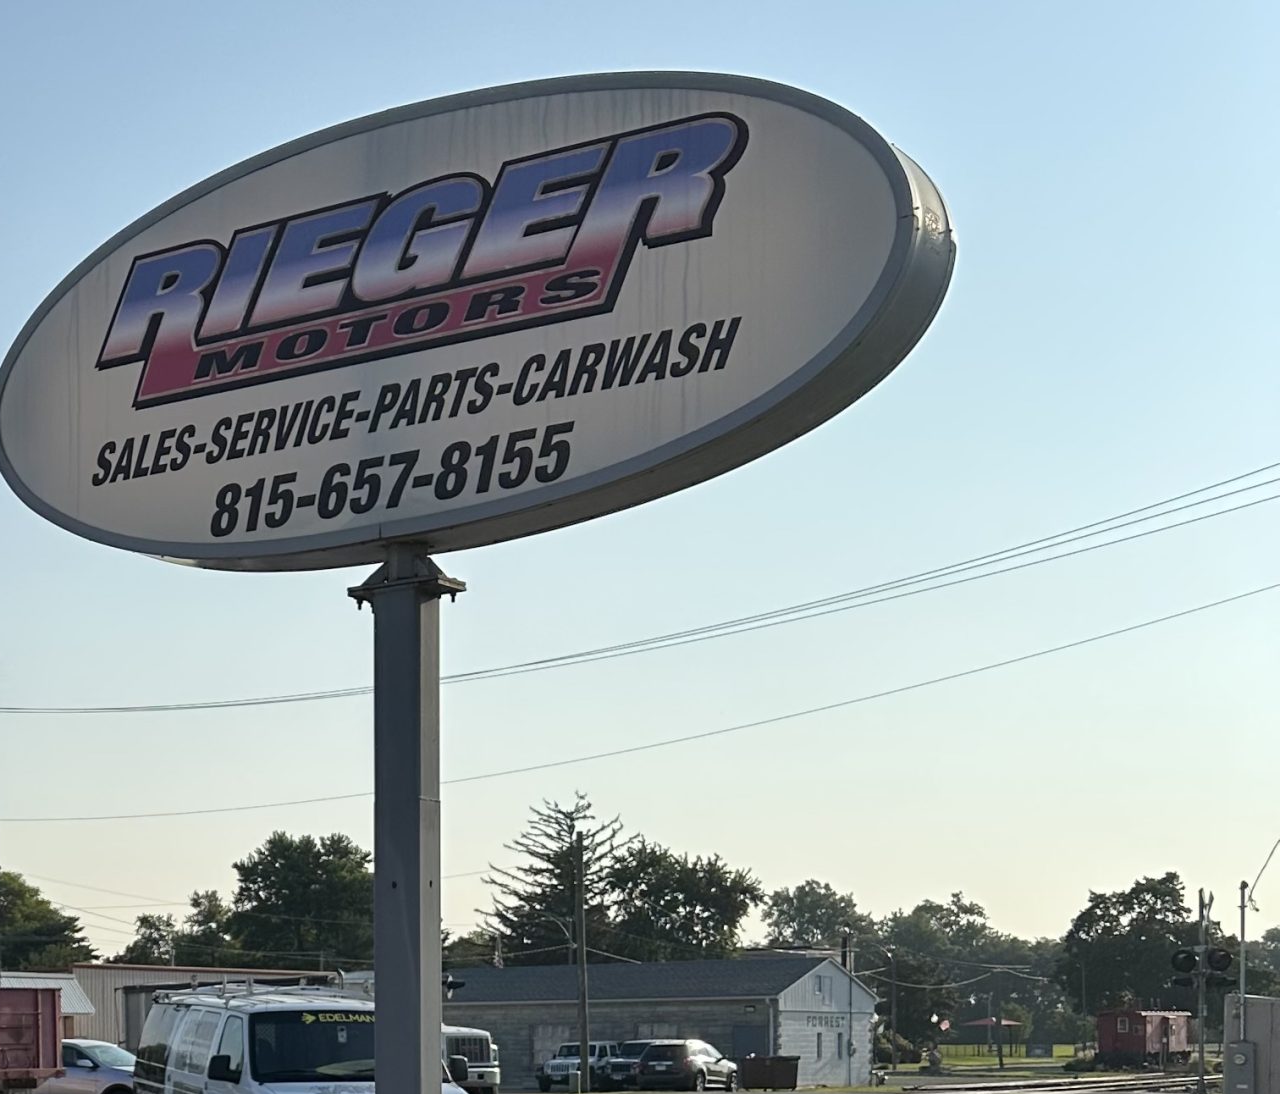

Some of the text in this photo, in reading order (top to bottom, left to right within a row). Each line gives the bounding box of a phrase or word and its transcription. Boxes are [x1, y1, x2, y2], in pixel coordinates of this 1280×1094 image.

[97, 112, 748, 400] RIEGER
[188, 267, 602, 385] MOTORS
[91, 316, 743, 487] SALES-SERVICE-PARTS-CARWASH
[210, 422, 575, 537] 815-657-8155
[806, 1016, 845, 1028] FORREST
